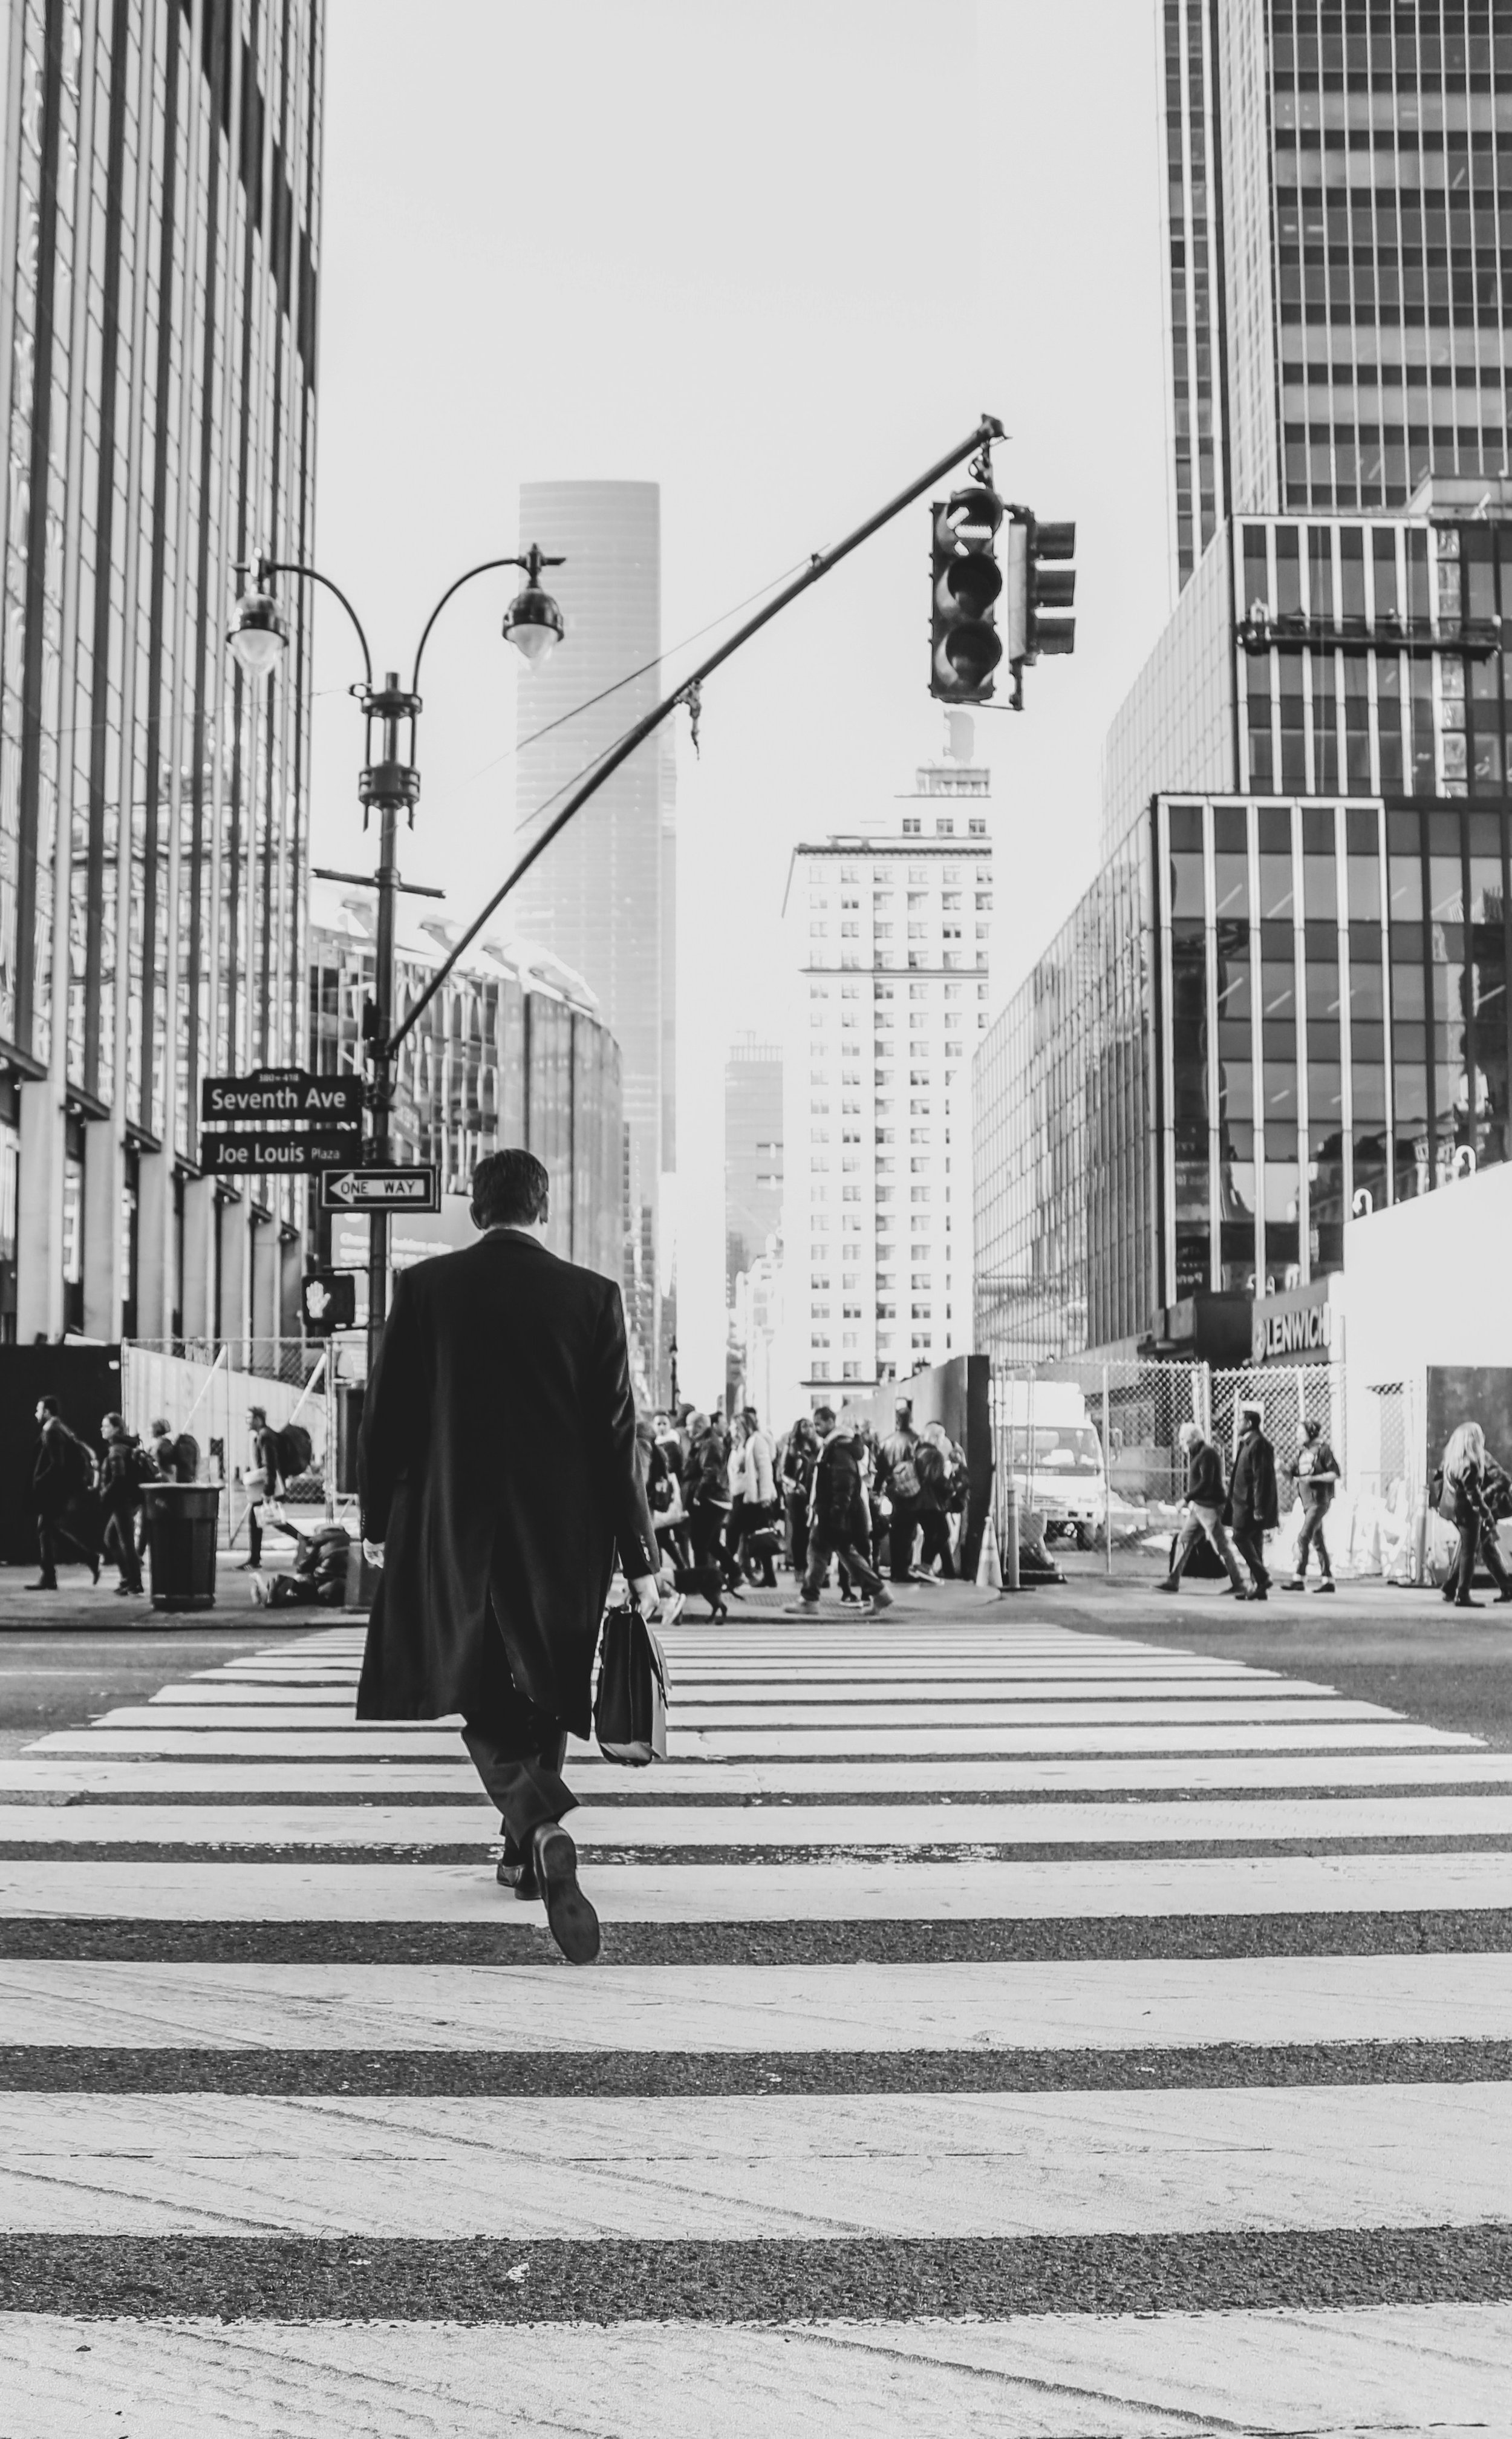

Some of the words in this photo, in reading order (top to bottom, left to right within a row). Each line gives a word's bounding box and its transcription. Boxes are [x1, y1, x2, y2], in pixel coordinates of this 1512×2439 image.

[212, 1086, 298, 1110] Seventh
[305, 1088, 346, 1108] Ave
[217, 1144, 248, 1163] Joe
[255, 1141, 304, 1163] Louis
[311, 1148, 340, 1160] Plaza
[341, 1181, 370, 1195] ONE
[384, 1181, 415, 1194] WAY
[1266, 1303, 1331, 1356] LENWICH
